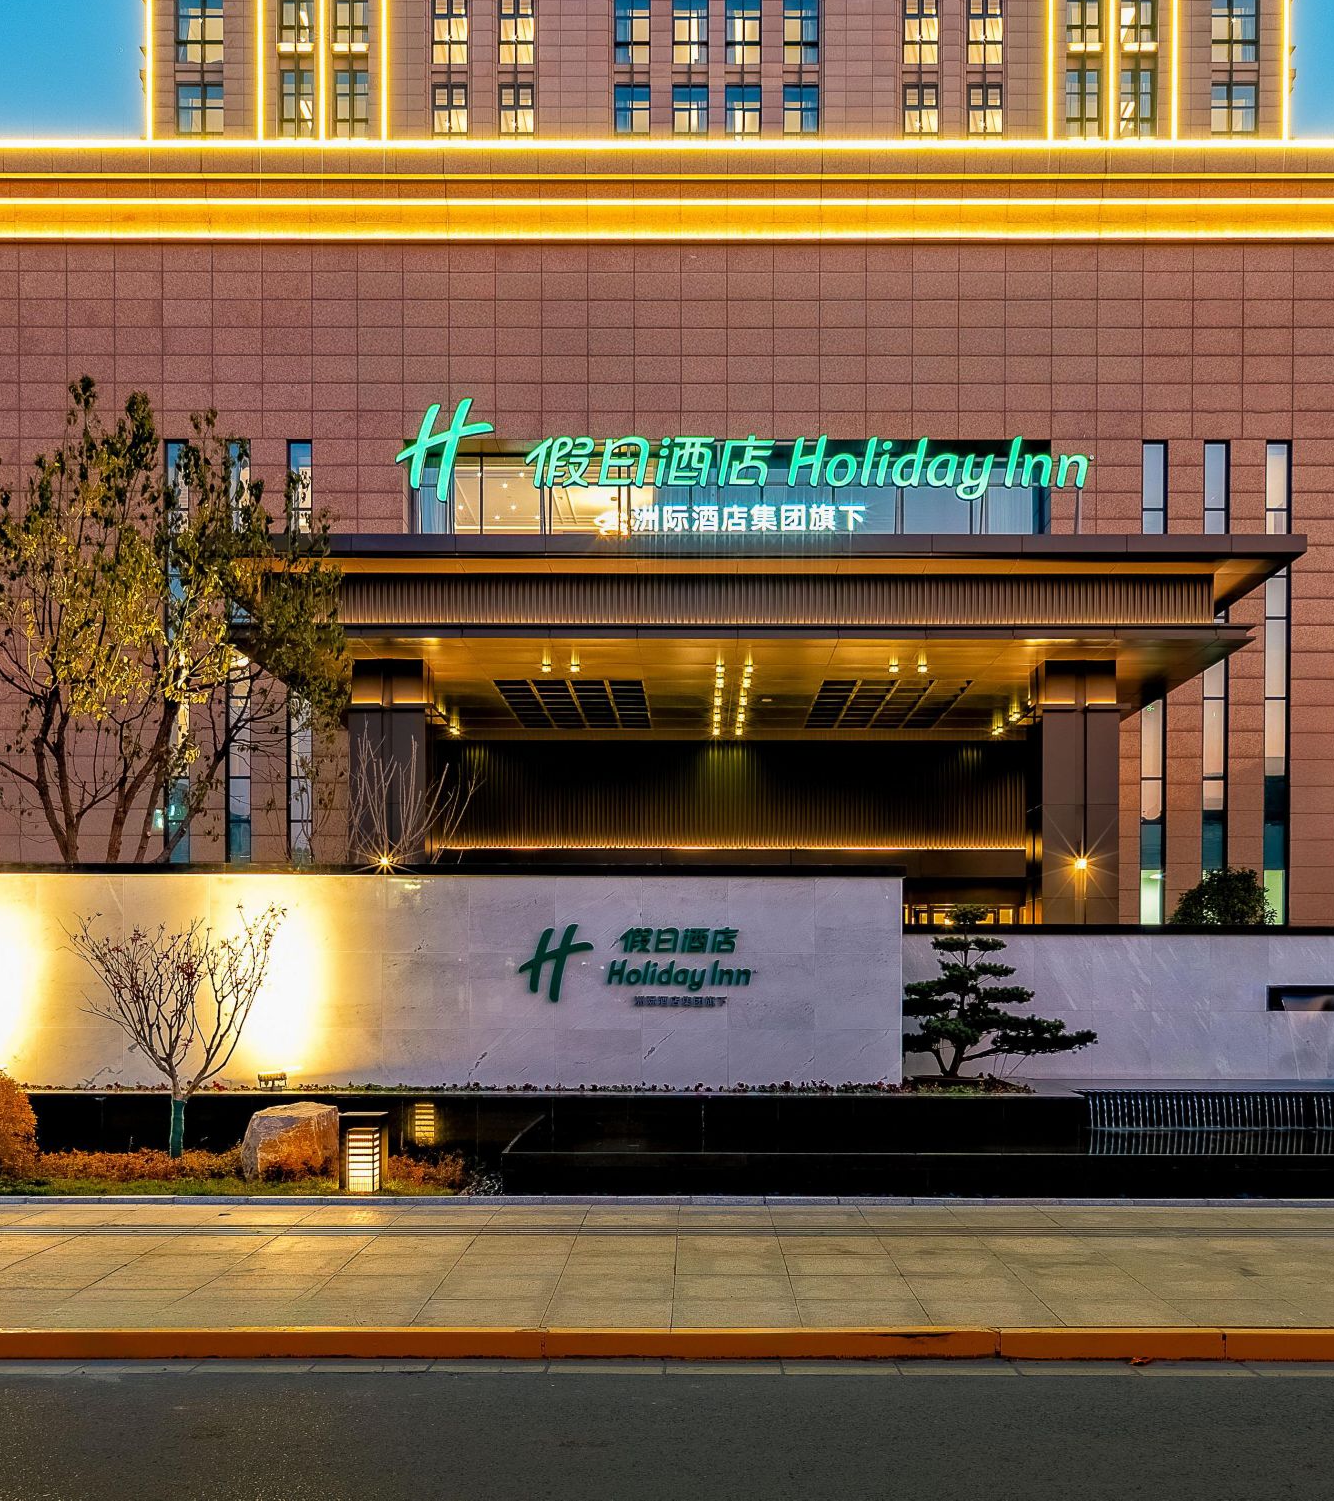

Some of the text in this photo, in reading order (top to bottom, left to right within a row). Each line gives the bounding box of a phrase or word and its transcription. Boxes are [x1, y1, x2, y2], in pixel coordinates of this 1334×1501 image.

[524, 434, 1089, 500] 假日酒店 Holiday Inn
[619, 926, 739, 954] 假日酒店
[607, 959, 752, 992] Holiday Inn
